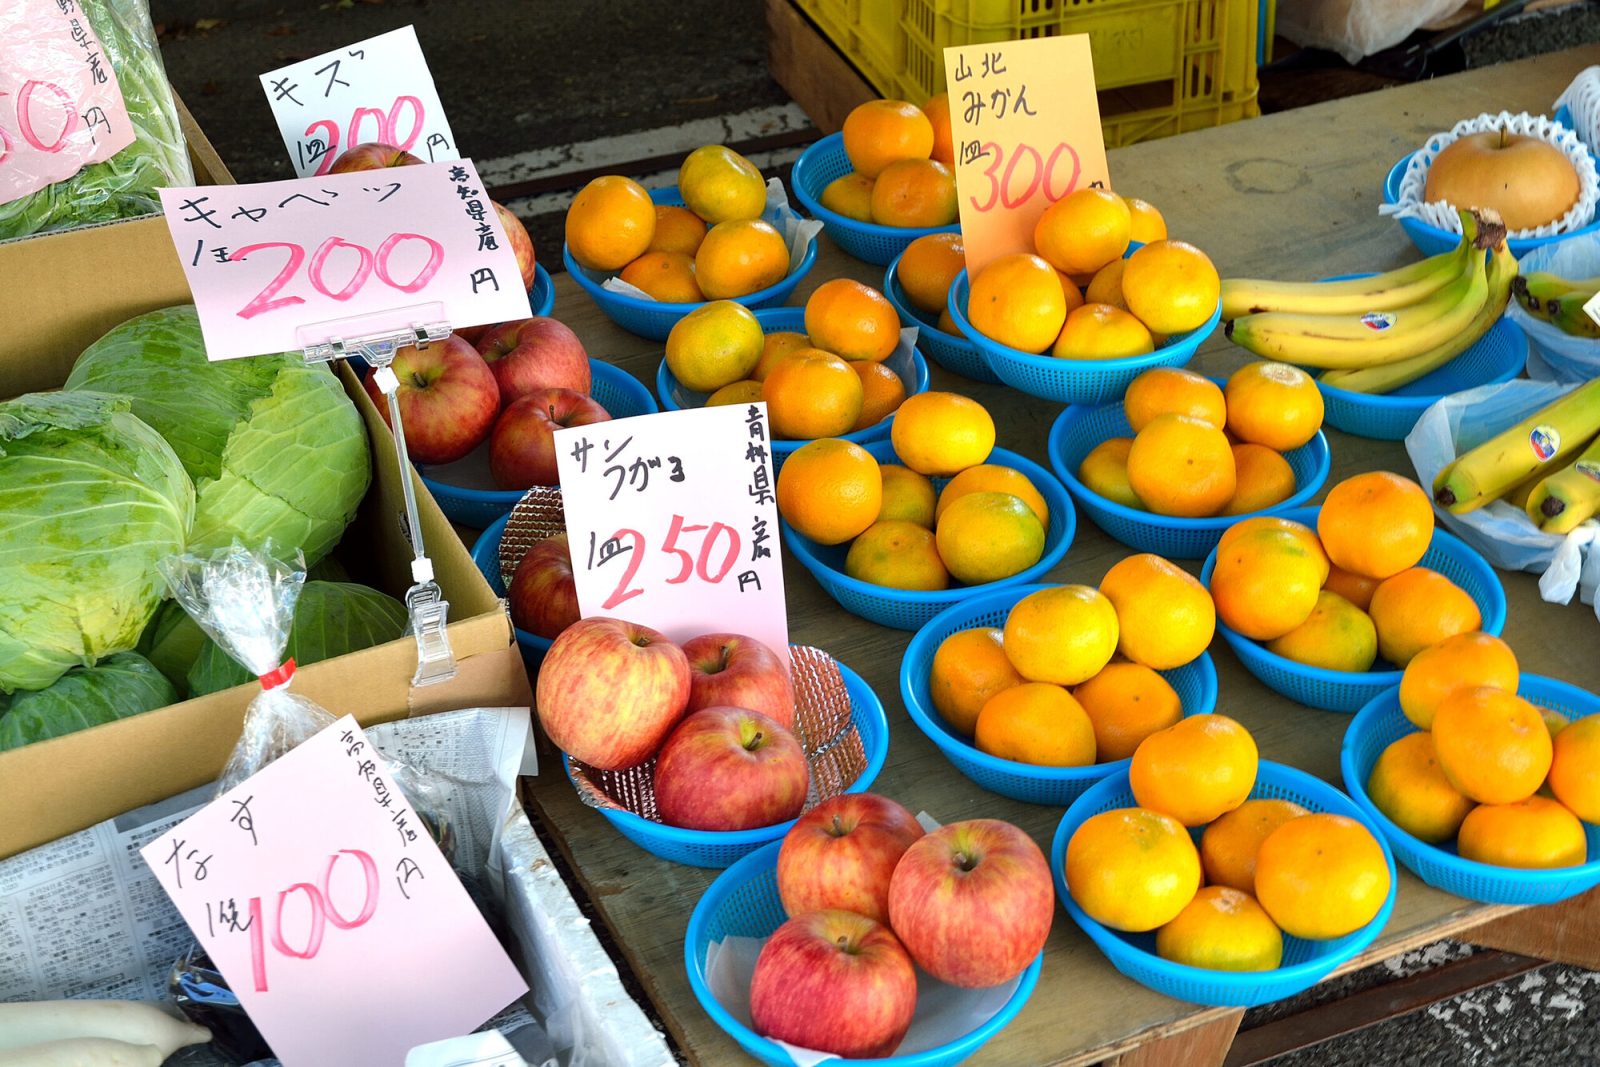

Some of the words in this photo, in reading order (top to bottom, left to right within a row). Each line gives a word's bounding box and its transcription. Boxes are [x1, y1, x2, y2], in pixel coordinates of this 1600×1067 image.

[270, 50, 364, 106] キズ
[955, 52, 1007, 82] 山北
[962, 84, 1037, 126] みかん
[0, 80, 78, 163] 0
[82, 106, 111, 145] 円
[304, 95, 425, 176] 200
[427, 132, 450, 163] 円
[179, 182, 402, 229] キャベツ
[970, 142, 1081, 212] 300
[229, 233, 444, 319] 200
[470, 267, 499, 293] 円
[601, 514, 741, 610] 250
[738, 570, 761, 592] 円
[165, 795, 258, 888] なす
[248, 849, 380, 992] 100
[396, 857, 424, 899] 円
